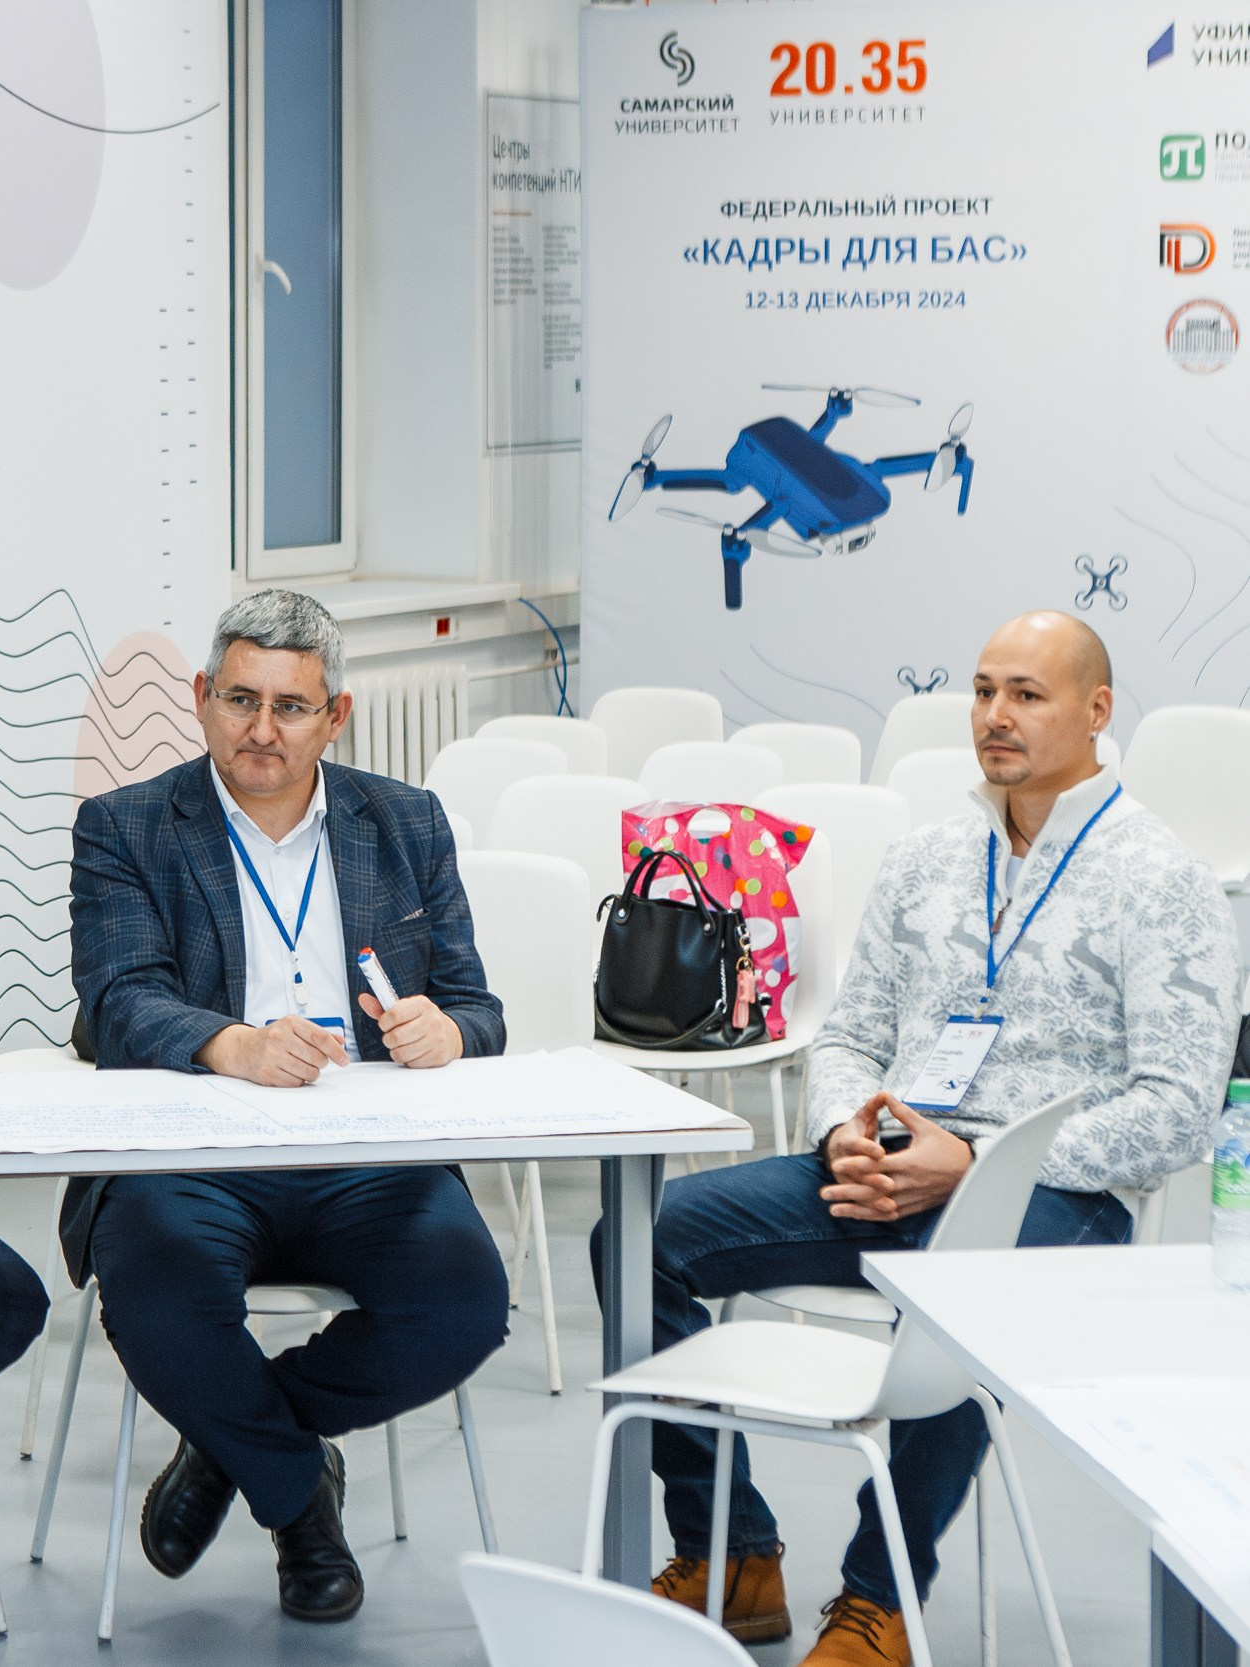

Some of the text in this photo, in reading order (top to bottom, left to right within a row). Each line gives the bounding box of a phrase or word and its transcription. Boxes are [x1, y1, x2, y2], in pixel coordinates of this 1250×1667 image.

[1192, 22, 1250, 41] УФИ
[769, 39, 928, 97] 20.35
[620, 94, 735, 113] САМАРСКИЙ
[614, 118, 740, 134] УНИВЕРСИТЕТ
[769, 107, 927, 125] УНИВЕРСИТЕТ
[1215, 131, 1250, 151] ПО
[492, 168, 582, 197] компетенций НТИ
[720, 194, 994, 222] ФЕДЕРАЛЬНЫЙ ПРОЕКТ
[683, 234, 1028, 272] «КАДРЫ ДЛЯ БАС»
[745, 291, 967, 313] 12-13 ДЕКАБРЯ 2024
